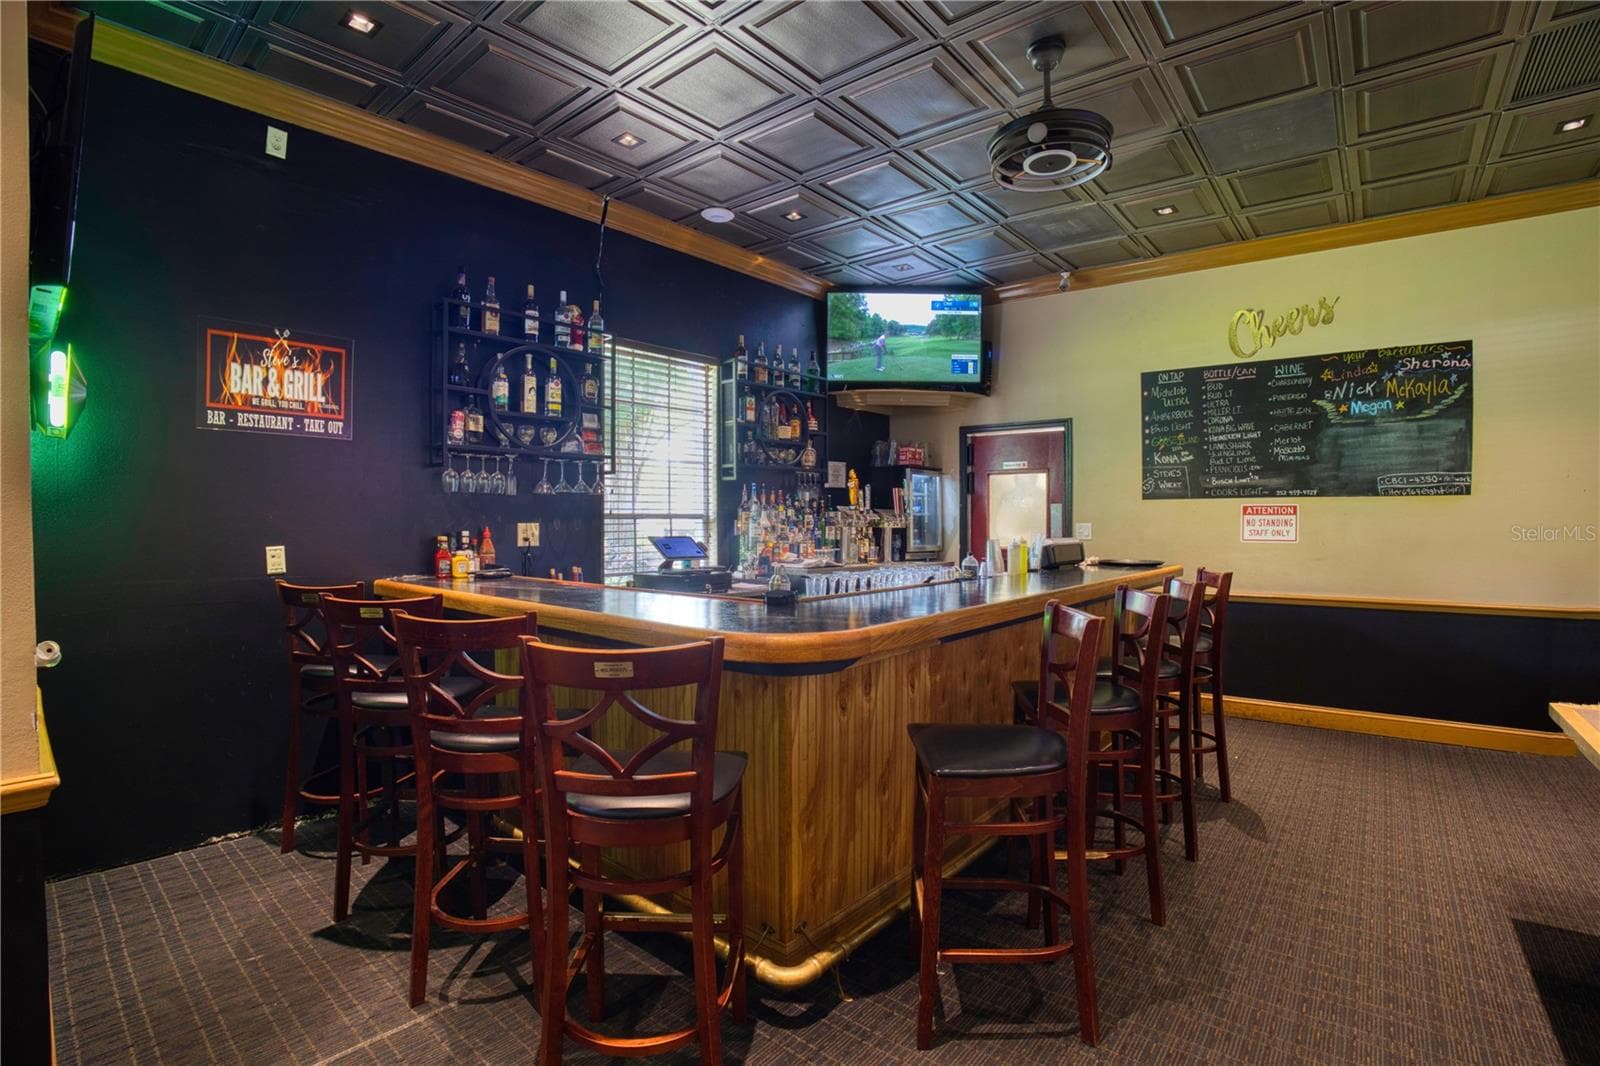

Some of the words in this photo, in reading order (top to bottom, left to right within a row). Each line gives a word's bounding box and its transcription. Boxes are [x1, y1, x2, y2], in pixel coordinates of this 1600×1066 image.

[1228, 296, 1340, 358] Cheers
[260, 348, 300, 368] Steve's
[1203, 367, 1257, 382] BOTTLE/CAN
[1274, 363, 1306, 378] WINE
[230, 362, 264, 397] BAR
[267, 368, 280, 398] &
[284, 369, 326, 403] GRILL
[1207, 383, 1224, 391] BUD
[1386, 375, 1451, 404] McKayla
[1333, 381, 1377, 400] Nick
[207, 410, 226, 425] BAR
[237, 413, 294, 430] RESTAURANT
[304, 418, 325, 433] TAKE
[328, 421, 344, 435] OUT
[1153, 452, 1180, 464] KONA
[1210, 488, 1239, 497] COORS
[1246, 506, 1295, 515] ATTENTION
[1246, 518, 1256, 528] NO
[1258, 518, 1294, 528] STANDING
[1248, 529, 1269, 537] STAFF
[1271, 528, 1290, 537] ONLY
